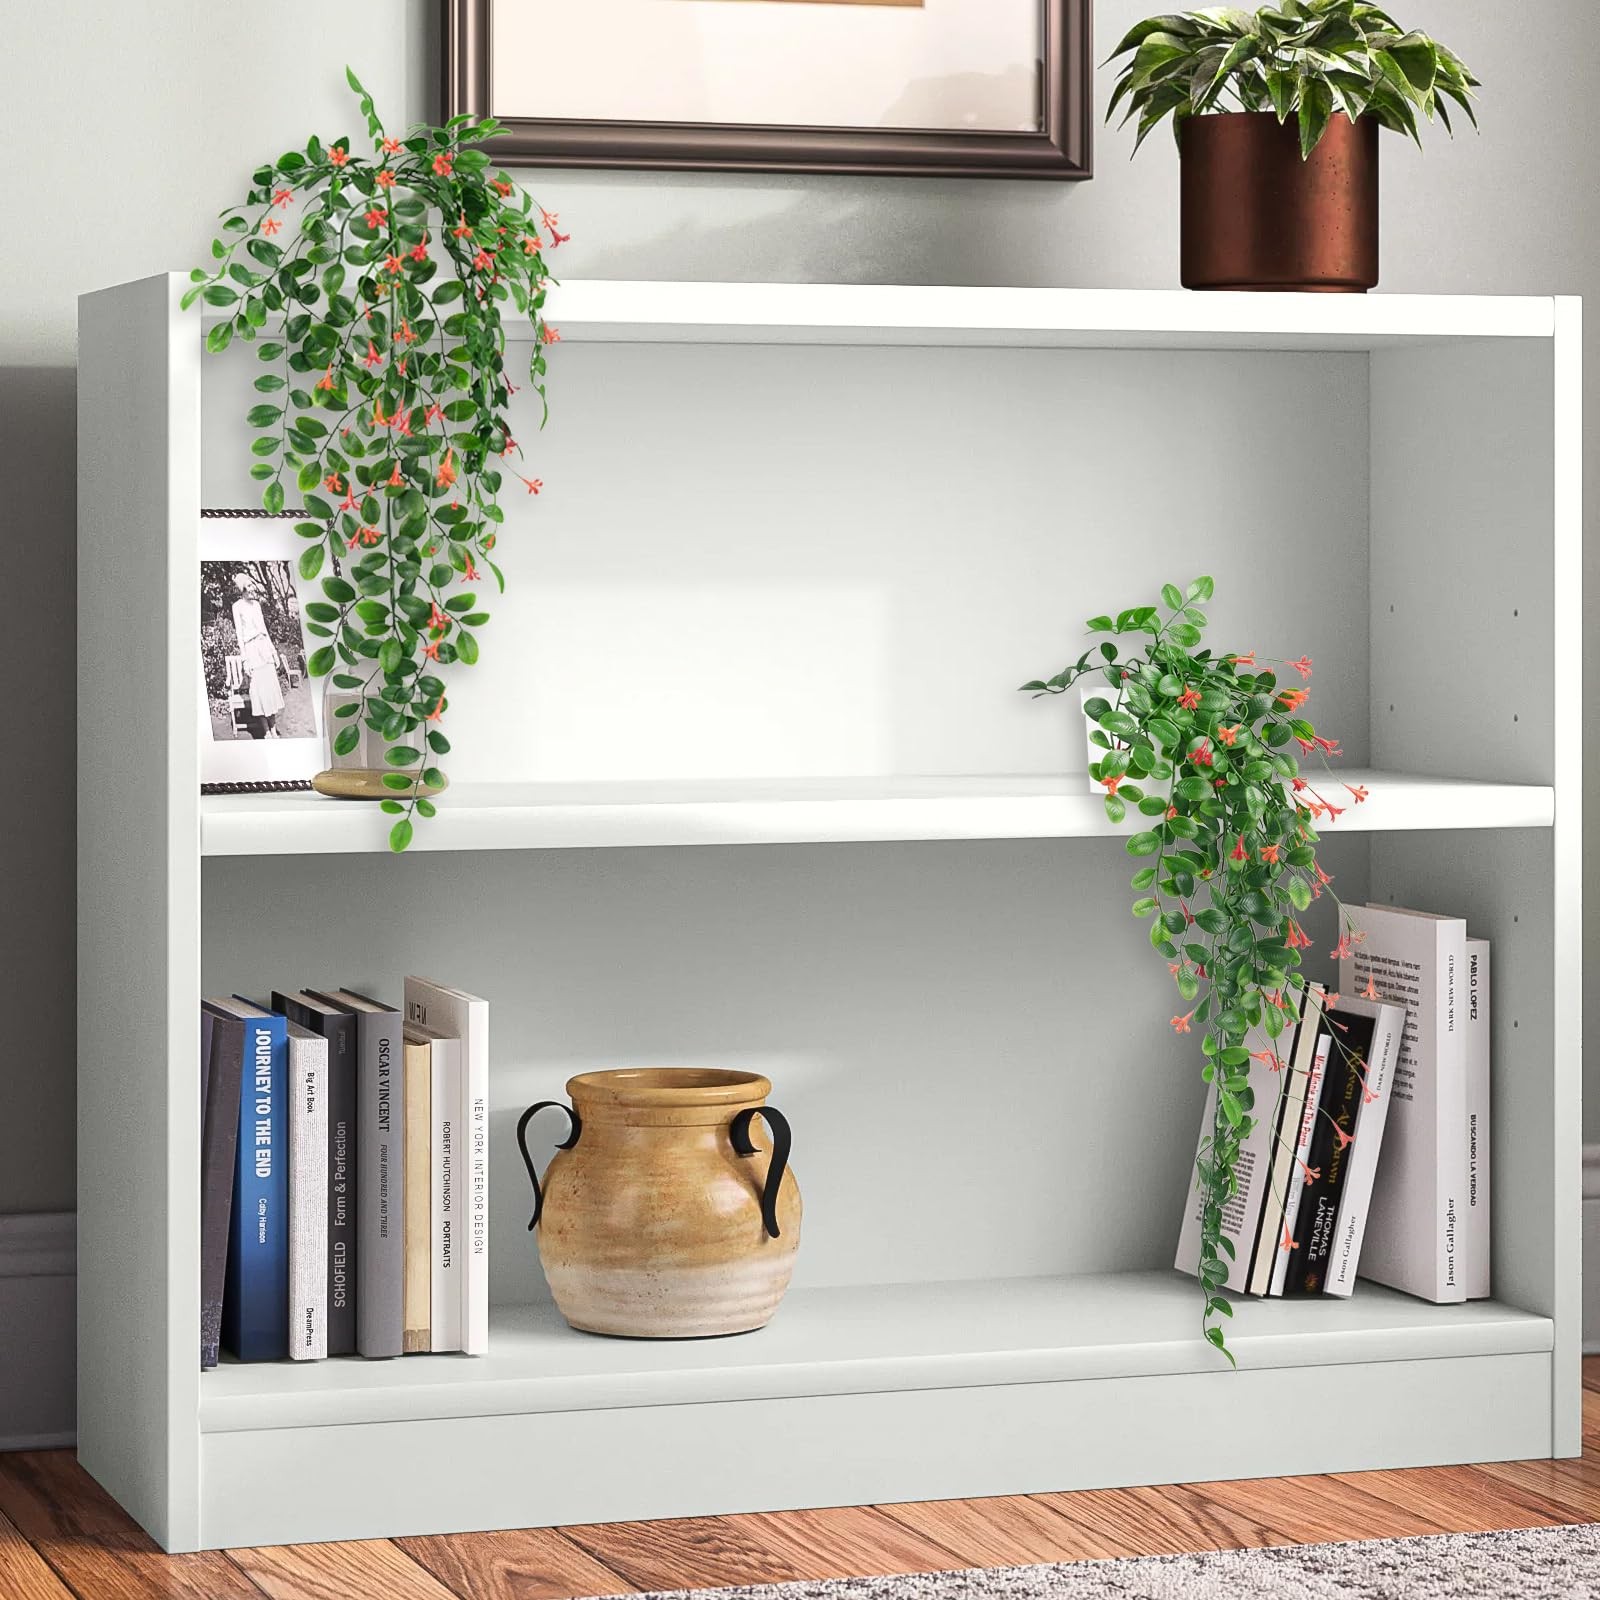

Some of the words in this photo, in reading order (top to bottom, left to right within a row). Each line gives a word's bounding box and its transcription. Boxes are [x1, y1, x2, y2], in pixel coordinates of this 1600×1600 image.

[1470, 954, 1478, 987] PABLO
[1470, 989, 1478, 1021] LOPEZ
[255, 1028, 272, 1094] JOURNEY
[378, 1038, 390, 1078] OSCAR
[1376, 1073, 1384, 1091] DARK
[1383, 1032, 1392, 1056] WORLD
[305, 1072, 315, 1084] Big
[306, 1085, 315, 1095] Art
[255, 1096, 272, 1115] TO
[306, 1097, 315, 1114] Book
[378, 1079, 390, 1132] VINCENT
[474, 1098, 484, 1121] NEW
[255, 1118, 272, 1146] THE
[442, 1121, 451, 1155] ROBERT
[474, 1126, 484, 1154] YORK
[255, 1149, 272, 1178] END
[334, 1121, 346, 1181] Perfection
[380, 1144, 388, 1163] FOUR
[1470, 1161, 1477, 1173] LA
[334, 1183, 346, 1193] &
[380, 1163, 388, 1198] HUNDRED
[442, 1156, 451, 1212] HUTCHINSON
[474, 1159, 484, 1210] INTERIOR
[257, 1198, 267, 1216] Colby
[334, 1196, 346, 1226] Form
[380, 1201, 388, 1214] AND
[258, 1216, 267, 1244] Harrison
[380, 1215, 388, 1239] THREE
[474, 1214, 484, 1254] DESIGN
[1308, 1196, 1328, 1262] LANEVILLE
[1318, 1205, 1335, 1256] THOMAS
[1446, 1198, 1457, 1253] Gallagher
[442, 1220, 451, 1268] PORTRAITS
[1337, 1259, 1348, 1283] Jason
[1343, 1216, 1357, 1257] Gallagher
[334, 1241, 346, 1308] SCHOFIELD
[1446, 1256, 1456, 1287] Jason
[305, 1307, 314, 1347] DreamPress
